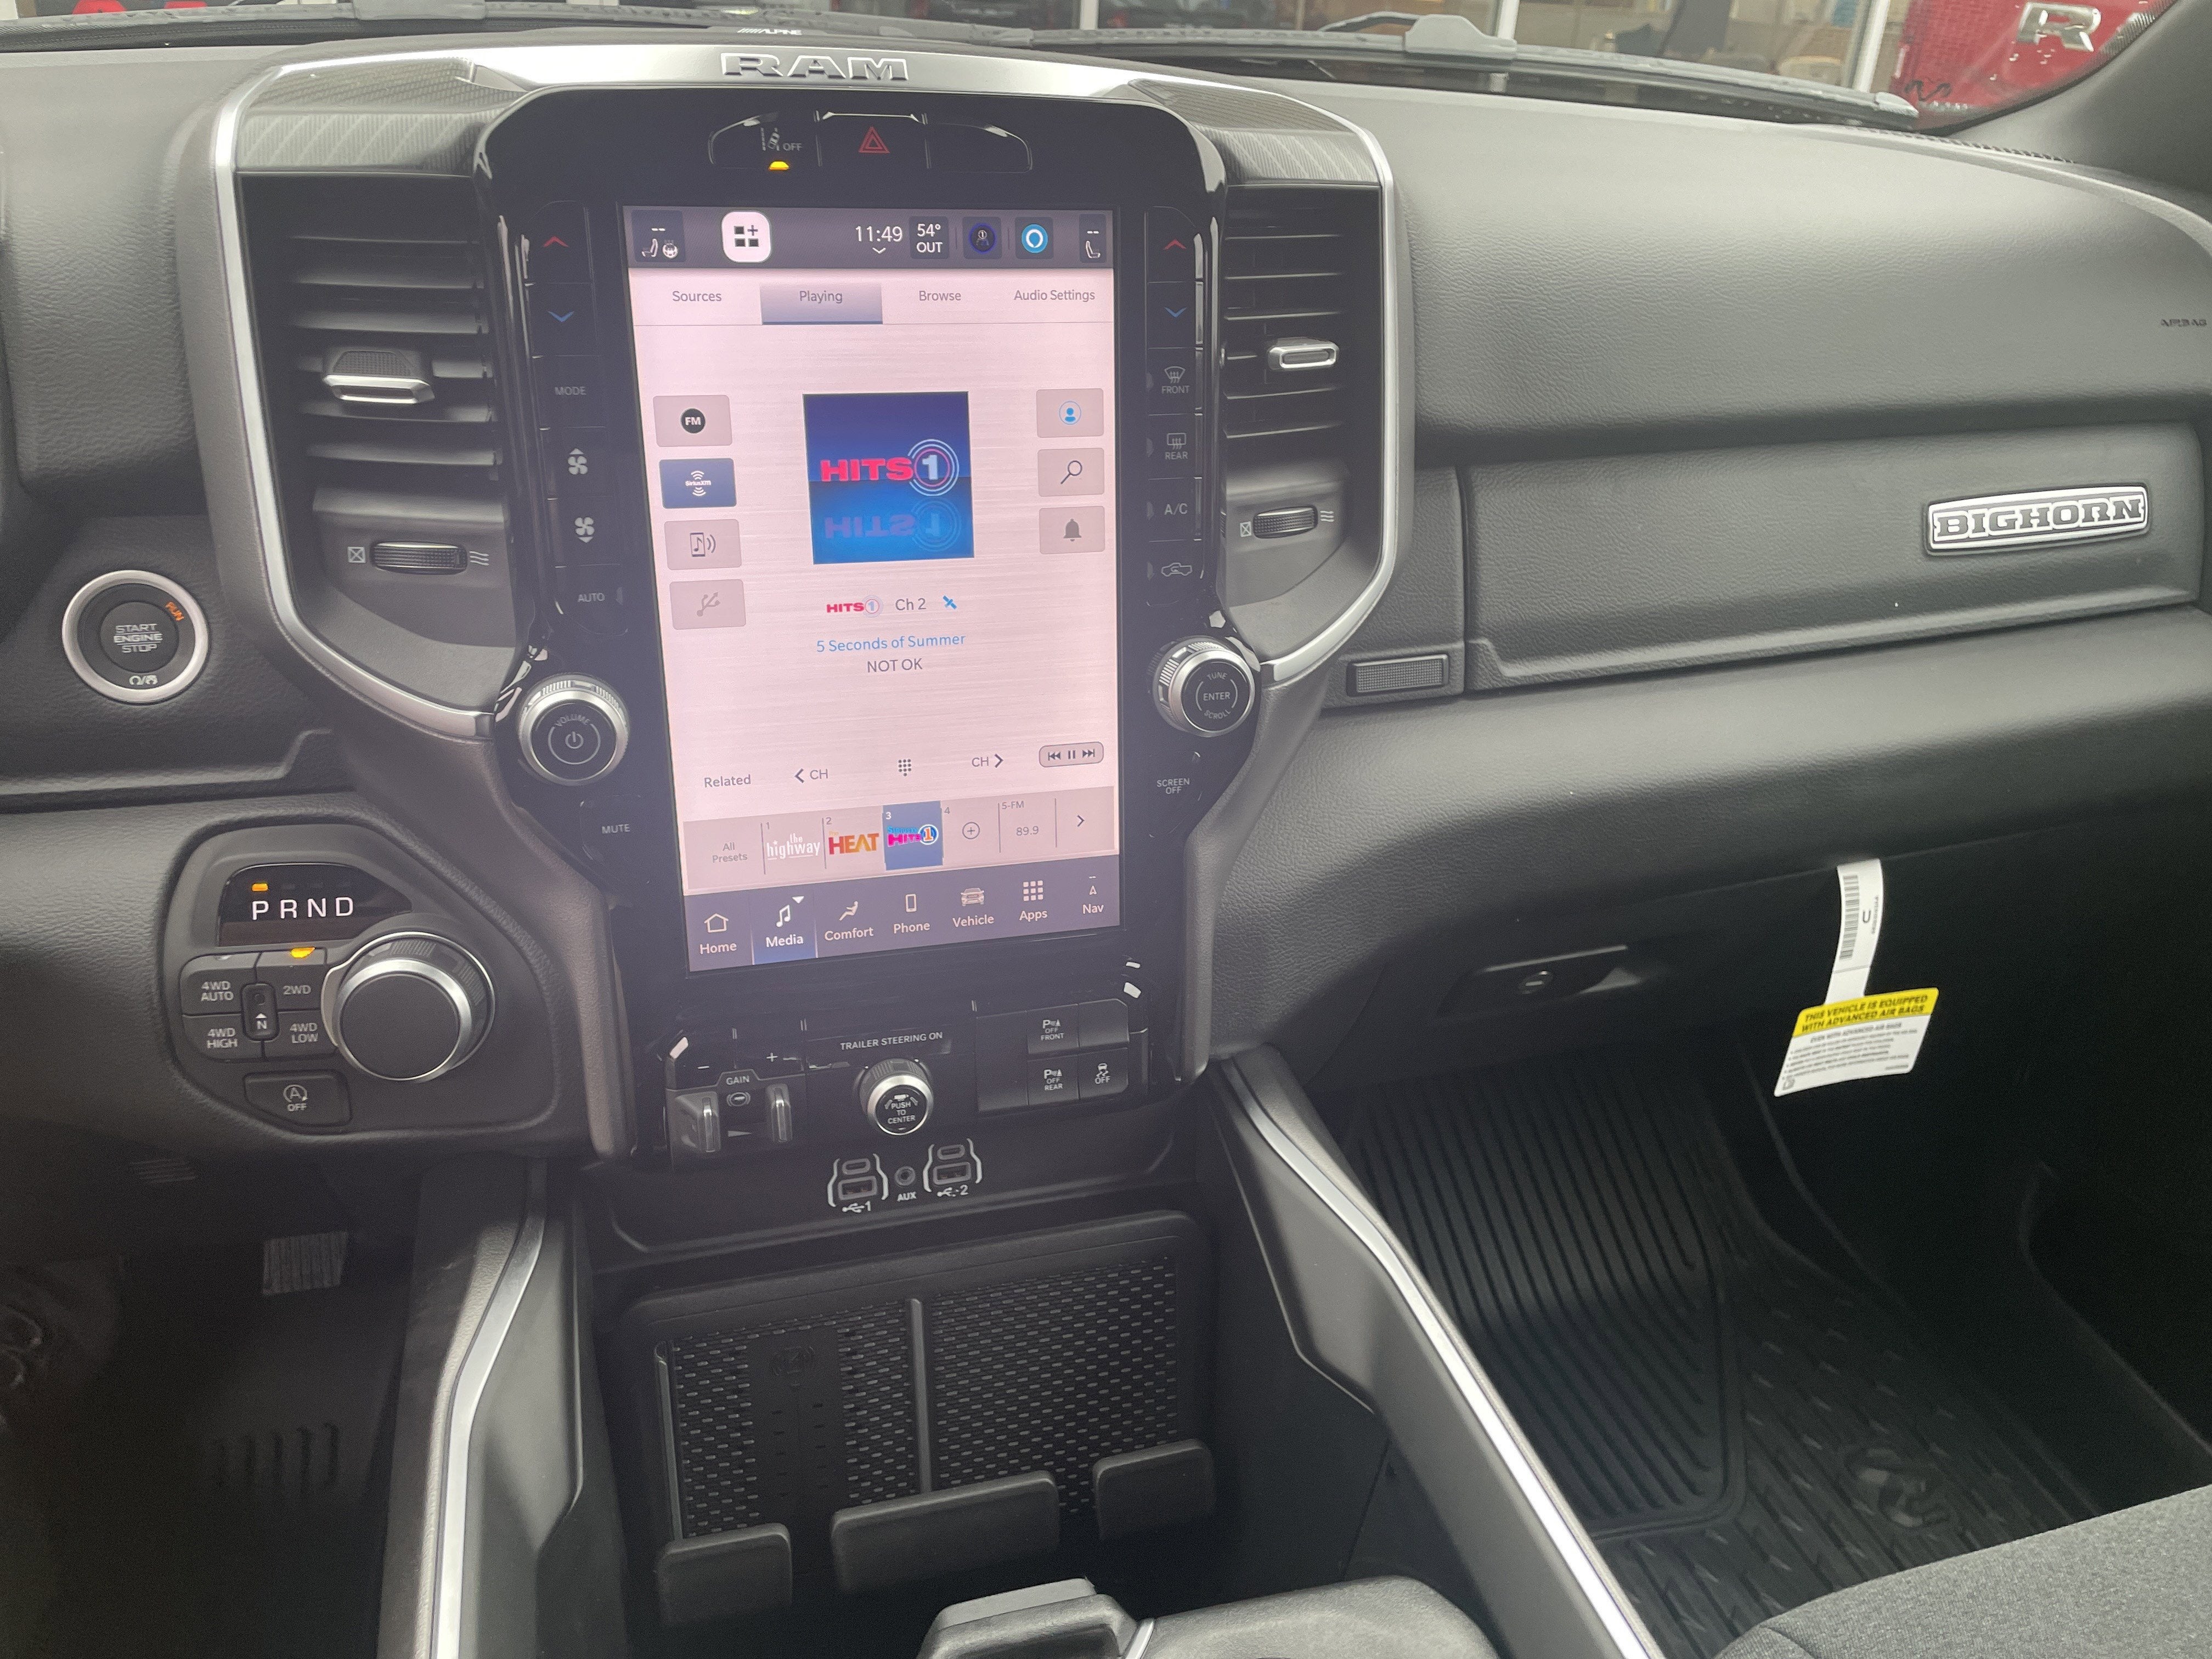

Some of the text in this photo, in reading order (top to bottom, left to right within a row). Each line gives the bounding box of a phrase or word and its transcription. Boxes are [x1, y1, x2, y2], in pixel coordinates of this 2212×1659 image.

[720, 53, 909, 81] RAM
[783, 143, 803, 151] OFF
[855, 225, 903, 242] 11:49
[916, 223, 941, 238] 54°
[916, 241, 943, 253] OUT
[672, 290, 722, 302] Sources
[799, 290, 843, 305] Playing
[918, 290, 961, 302] Browse
[1014, 290, 1095, 303] Audio Settings
[555, 386, 586, 396] MODE
[1161, 385, 1189, 394] FRONT
[685, 416, 701, 425] FM
[1165, 452, 1188, 460] REAR
[1164, 503, 1188, 515] A/C
[1935, 496, 2143, 540] BIGHORN
[578, 592, 605, 602] AUTO
[895, 597, 927, 611] Ch 2
[115, 623, 157, 633] START
[114, 633, 163, 643] ENGINE
[817, 634, 966, 652] 5 Seconds of Summer
[122, 644, 157, 653] STOP
[867, 658, 923, 673] NOT OK
[1207, 671, 1228, 681] TUNE
[1203, 691, 1231, 702] ENTER
[1204, 709, 1231, 720] SCROLL
[555, 714, 590, 727] VOLUME
[972, 757, 989, 768] CH
[810, 769, 828, 780] CH
[704, 774, 751, 788] Related
[1156, 777, 1190, 788] SCREEN
[1165, 786, 1182, 795] OFF
[944, 806, 950, 815] 4
[1001, 800, 1024, 810] 5-FM
[826, 817, 832, 825] 2
[885, 811, 891, 820] 3
[601, 823, 630, 834] MUTE
[1015, 826, 1039, 837] 89.9
[789, 833, 803, 844] the
[828, 833, 879, 855] HEAT
[723, 842, 735, 851] All
[766, 840, 820, 859] highway
[712, 854, 748, 864] Presets
[252, 896, 354, 920] P R N D
[1082, 903, 1104, 915] Nav
[952, 914, 995, 928] Vehicle
[1019, 909, 1048, 922] Apps
[893, 921, 930, 934] Phone
[824, 927, 874, 941] Comfort
[766, 934, 804, 947] Media
[699, 941, 737, 955] Home
[201, 981, 231, 991] 4WD
[283, 985, 312, 995] 2WD
[201, 991, 234, 1002] AUTO
[1805, 995, 1928, 1022] THIS VEHICLE IS EQUIPPED
[1802, 1005, 1925, 1032] WITH ADVANCED AIR BAGS
[256, 1020, 267, 1030] N
[290, 1022, 318, 1032] 4WD
[207, 1028, 235, 1037] 4WD
[291, 1032, 319, 1044] LOW
[1041, 1032, 1065, 1041] FRONT
[207, 1038, 238, 1048] HIGH
[840, 1031, 943, 1050] TRAILER STEERING ON
[726, 1075, 750, 1085] GAIN
[1094, 1076, 1111, 1085] OFF
[287, 1102, 307, 1112] OFF
[891, 1101, 911, 1109] PUSH
[887, 1115, 916, 1125] CENTER
[897, 1192, 917, 1202] AUX
